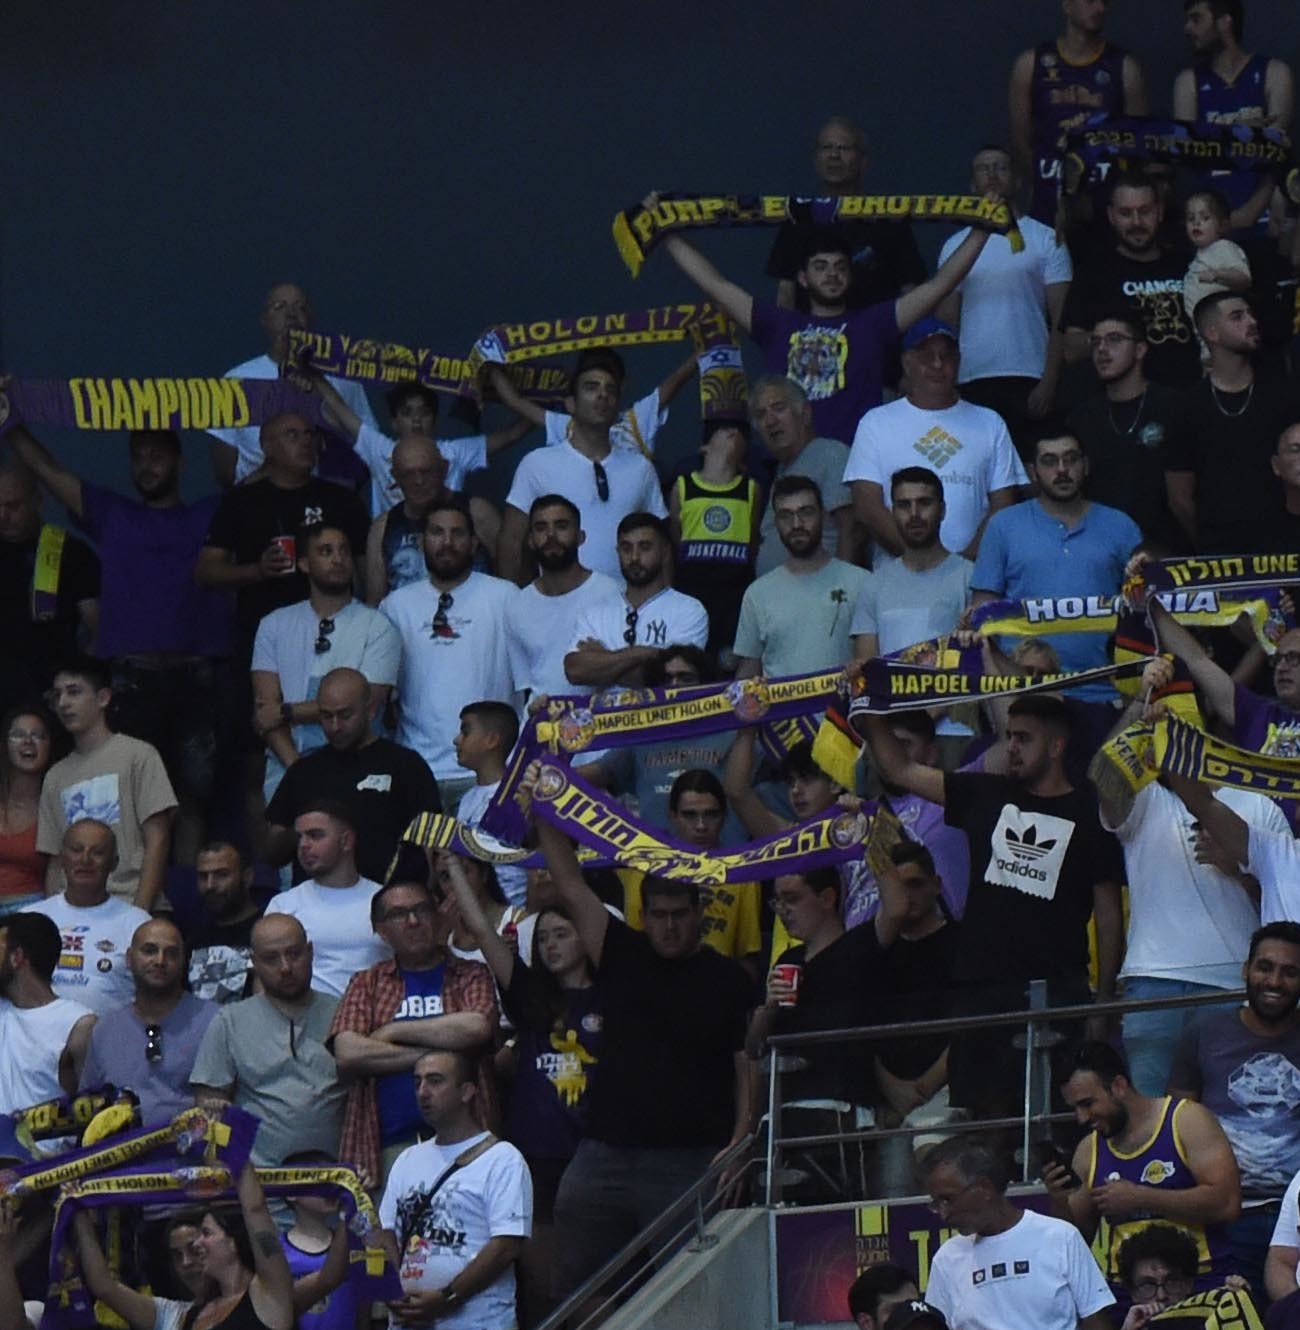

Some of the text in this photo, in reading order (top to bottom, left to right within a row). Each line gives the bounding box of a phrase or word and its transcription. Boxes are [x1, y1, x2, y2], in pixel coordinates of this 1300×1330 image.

[505, 312, 627, 345] HOLON
[69, 377, 250, 430] CHAMPIONS
[1166, 555, 1245, 587] חולון
[890, 673, 970, 695] HAPOEL
[597, 709, 644, 730] HAPOEL
[680, 698, 722, 719] HOLON
[995, 857, 1048, 883] adidas
